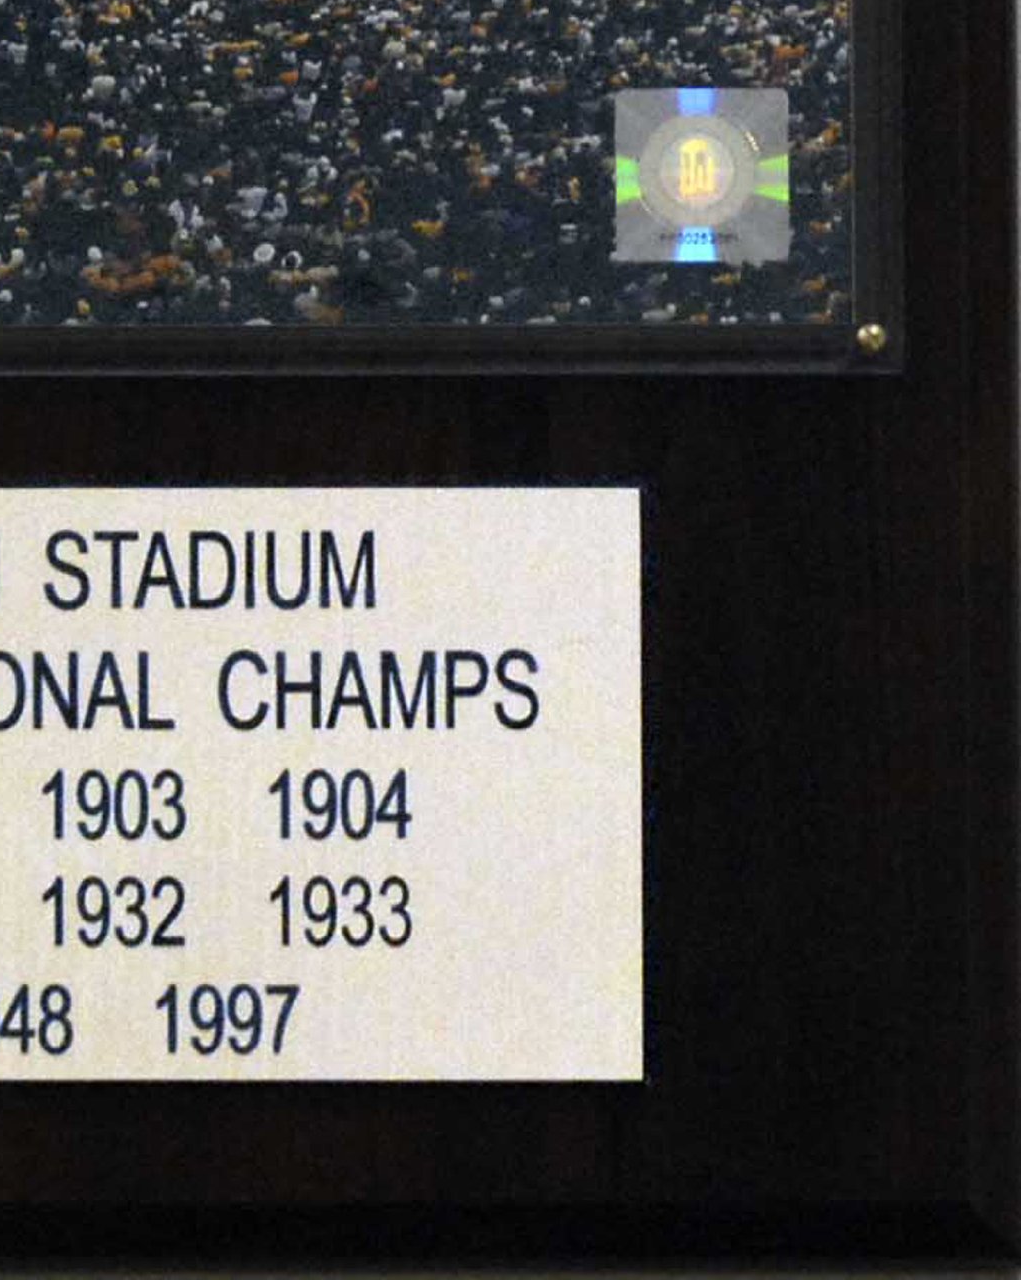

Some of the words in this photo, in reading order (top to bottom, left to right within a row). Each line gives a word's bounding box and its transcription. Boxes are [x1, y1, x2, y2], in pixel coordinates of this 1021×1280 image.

[44, 530, 375, 611] STADIUM
[218, 649, 539, 731] CHAMPS
[42, 769, 186, 841] 1903
[269, 769, 412, 840] 1904
[43, 876, 185, 948] 1932
[270, 876, 412, 947] 1933
[156, 984, 299, 1055] 1997
